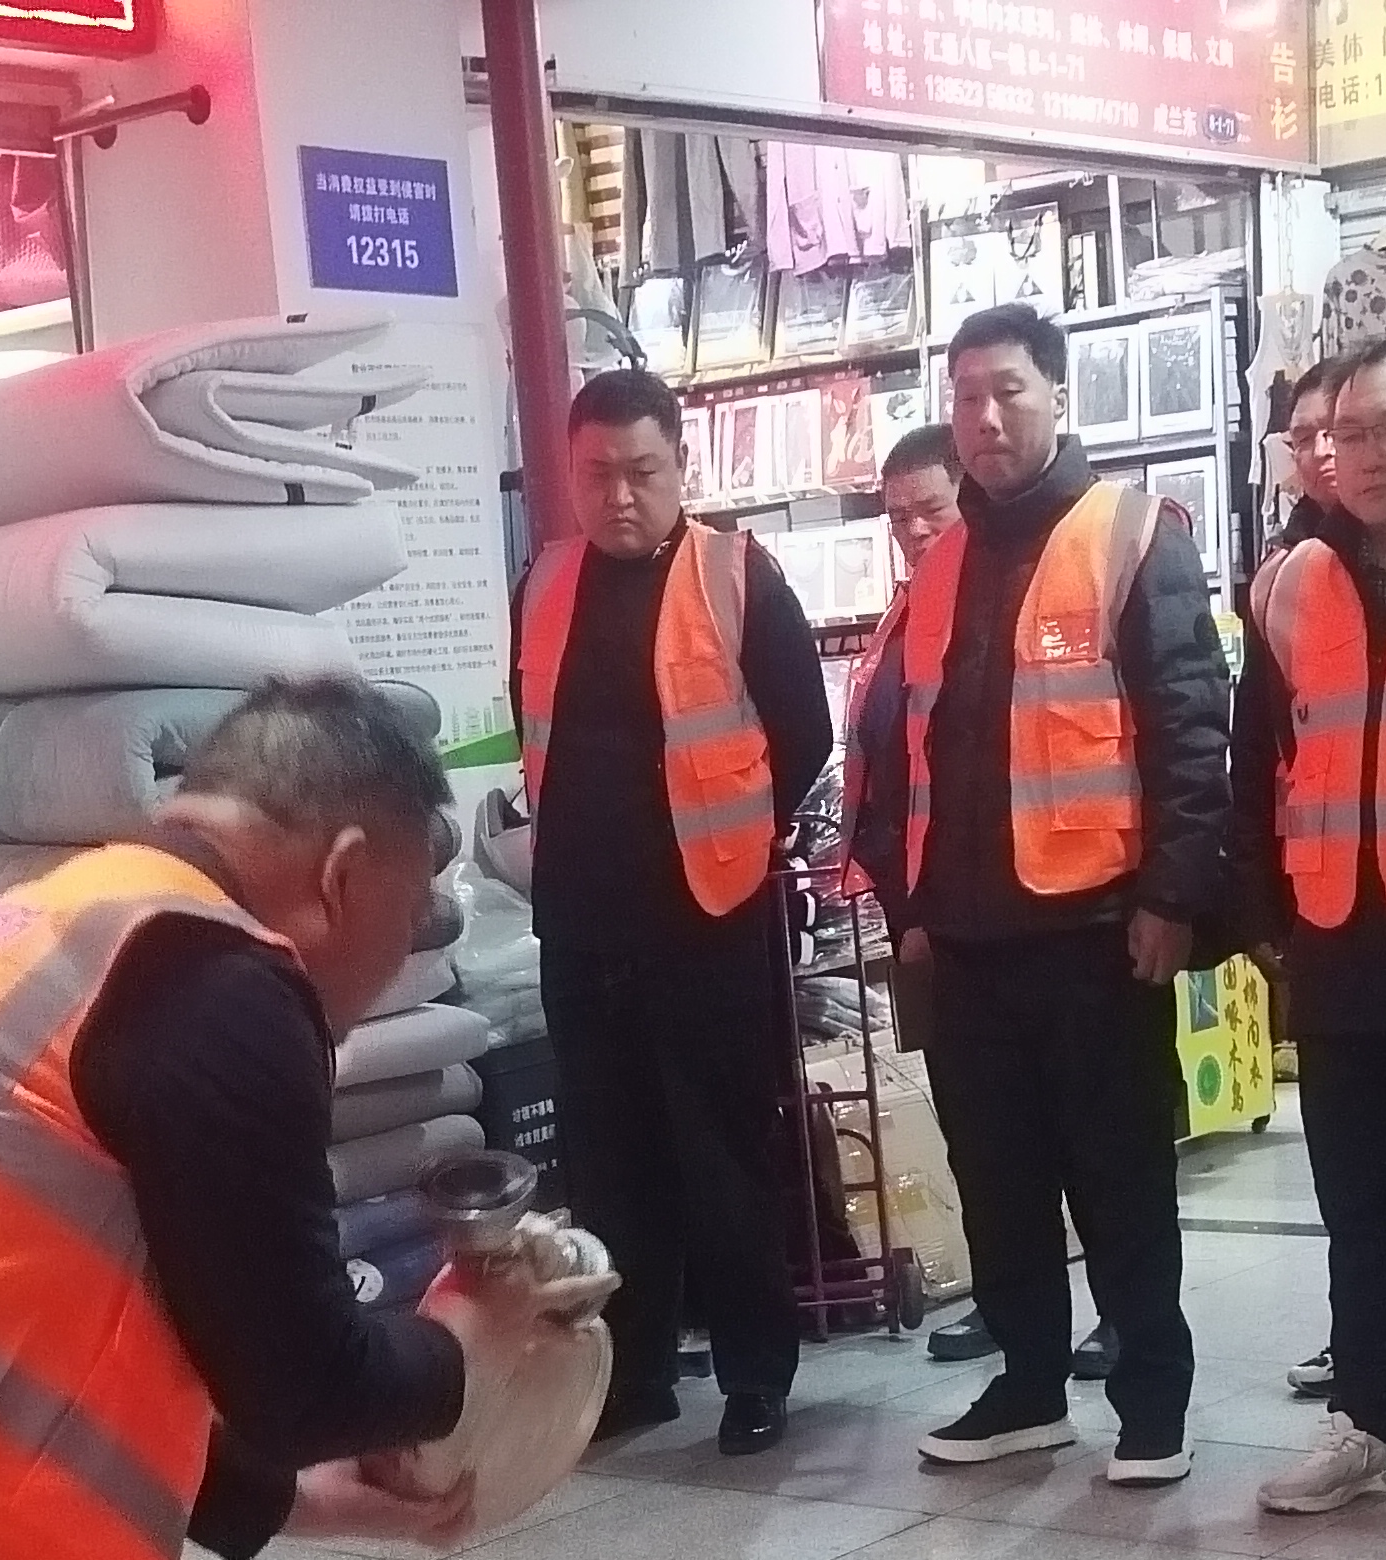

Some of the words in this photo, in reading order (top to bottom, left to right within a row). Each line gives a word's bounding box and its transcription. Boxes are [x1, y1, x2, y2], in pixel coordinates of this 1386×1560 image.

[1313, 33, 1364, 71] 美体
[316, 172, 437, 201] 当消费权益受到侵害时
[349, 203, 410, 226] 请拨打电话
[346, 235, 420, 270] 12315
